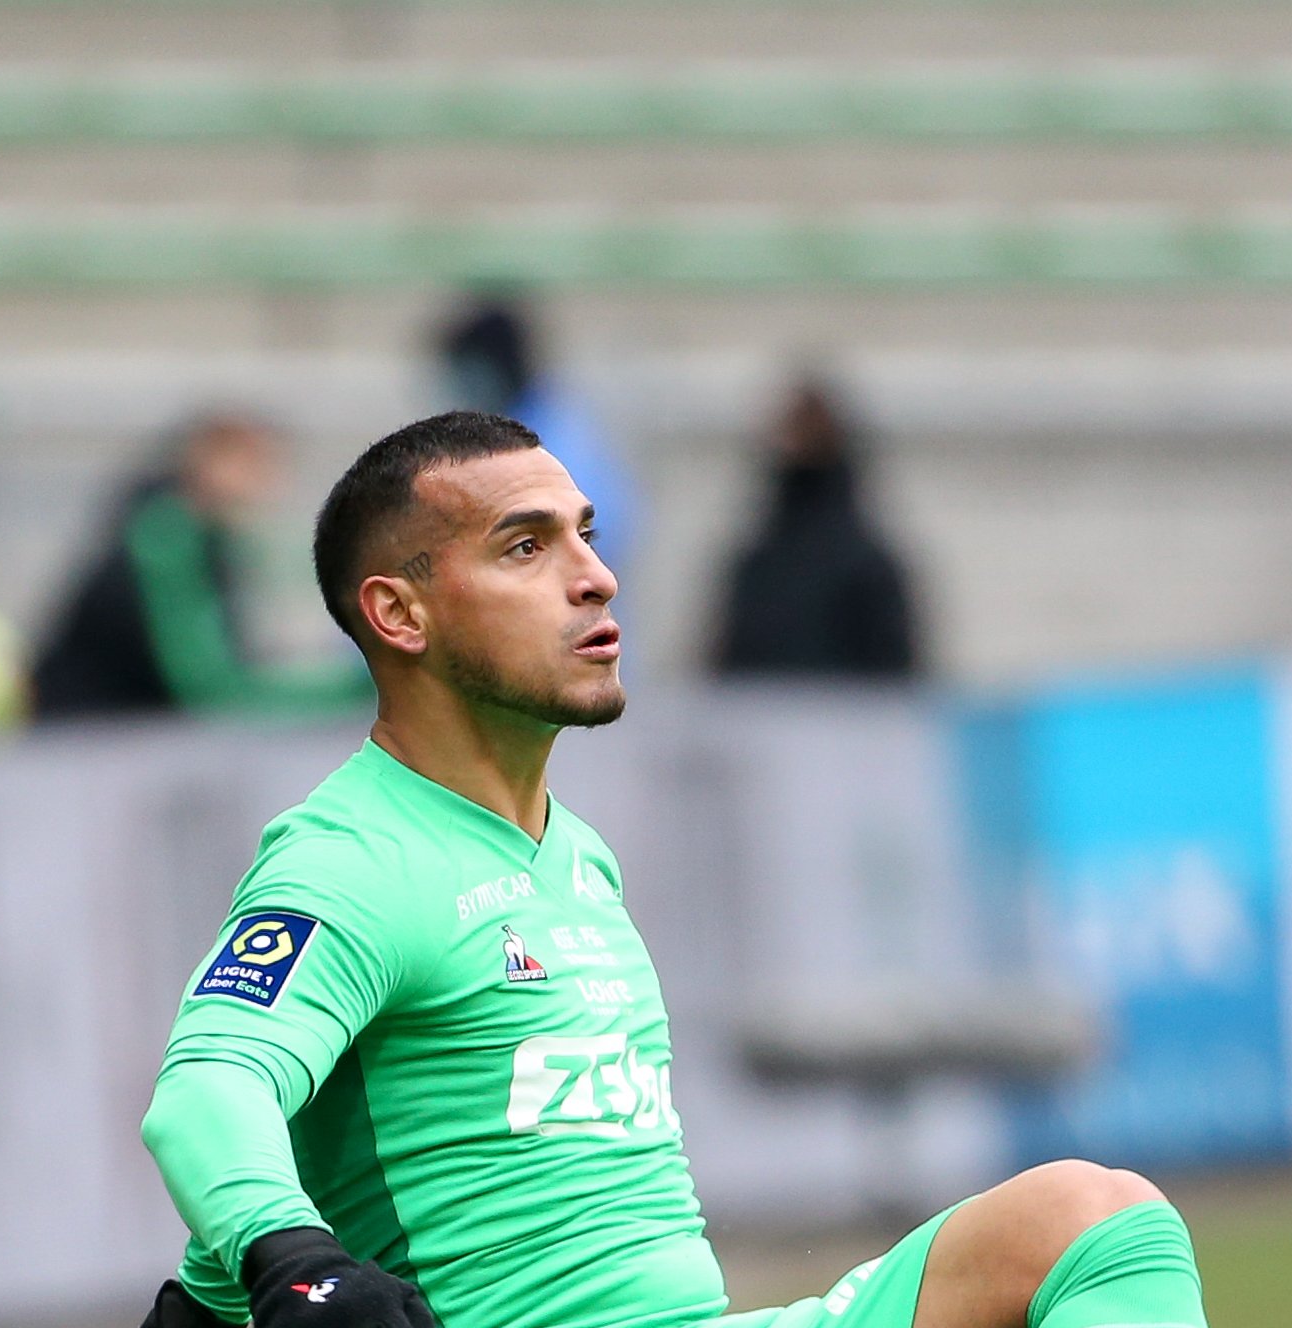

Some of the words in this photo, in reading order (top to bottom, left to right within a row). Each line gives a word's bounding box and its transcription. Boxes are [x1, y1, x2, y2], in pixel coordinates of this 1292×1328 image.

[214, 966, 263, 982] LIGUE
[265, 976, 274, 987] 1
[203, 978, 236, 989] Uber
[236, 981, 269, 998] Eats
